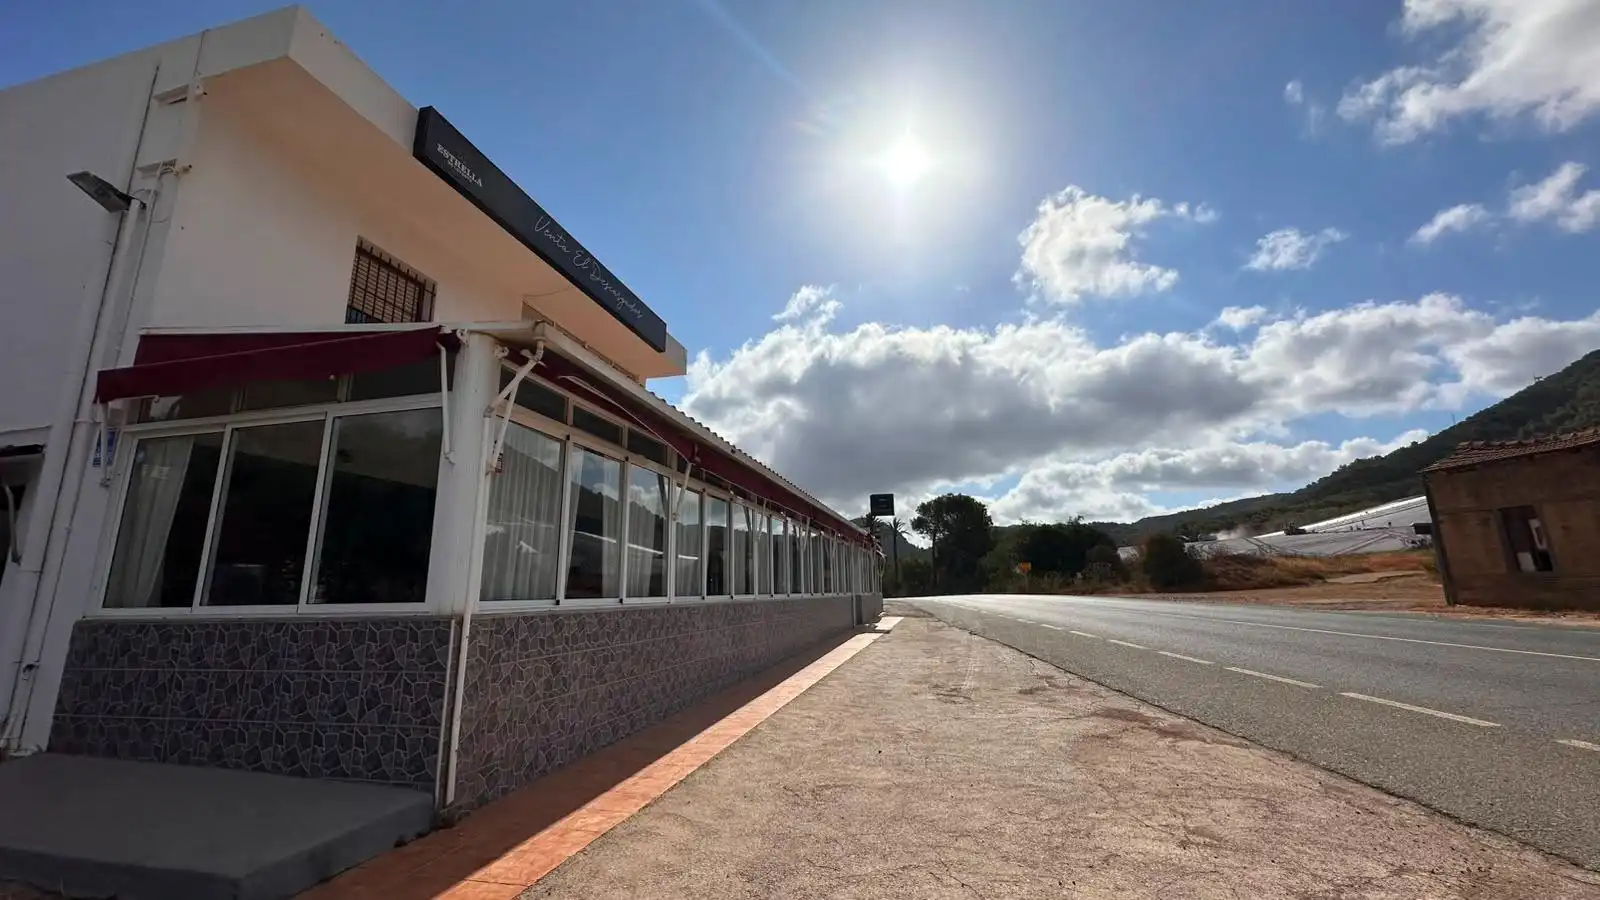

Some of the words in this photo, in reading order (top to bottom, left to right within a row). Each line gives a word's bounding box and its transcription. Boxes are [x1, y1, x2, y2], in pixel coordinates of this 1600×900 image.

[436, 143, 483, 187] ESTRELLA
[534, 216, 570, 253] Venta
[573, 250, 590, 269] El
